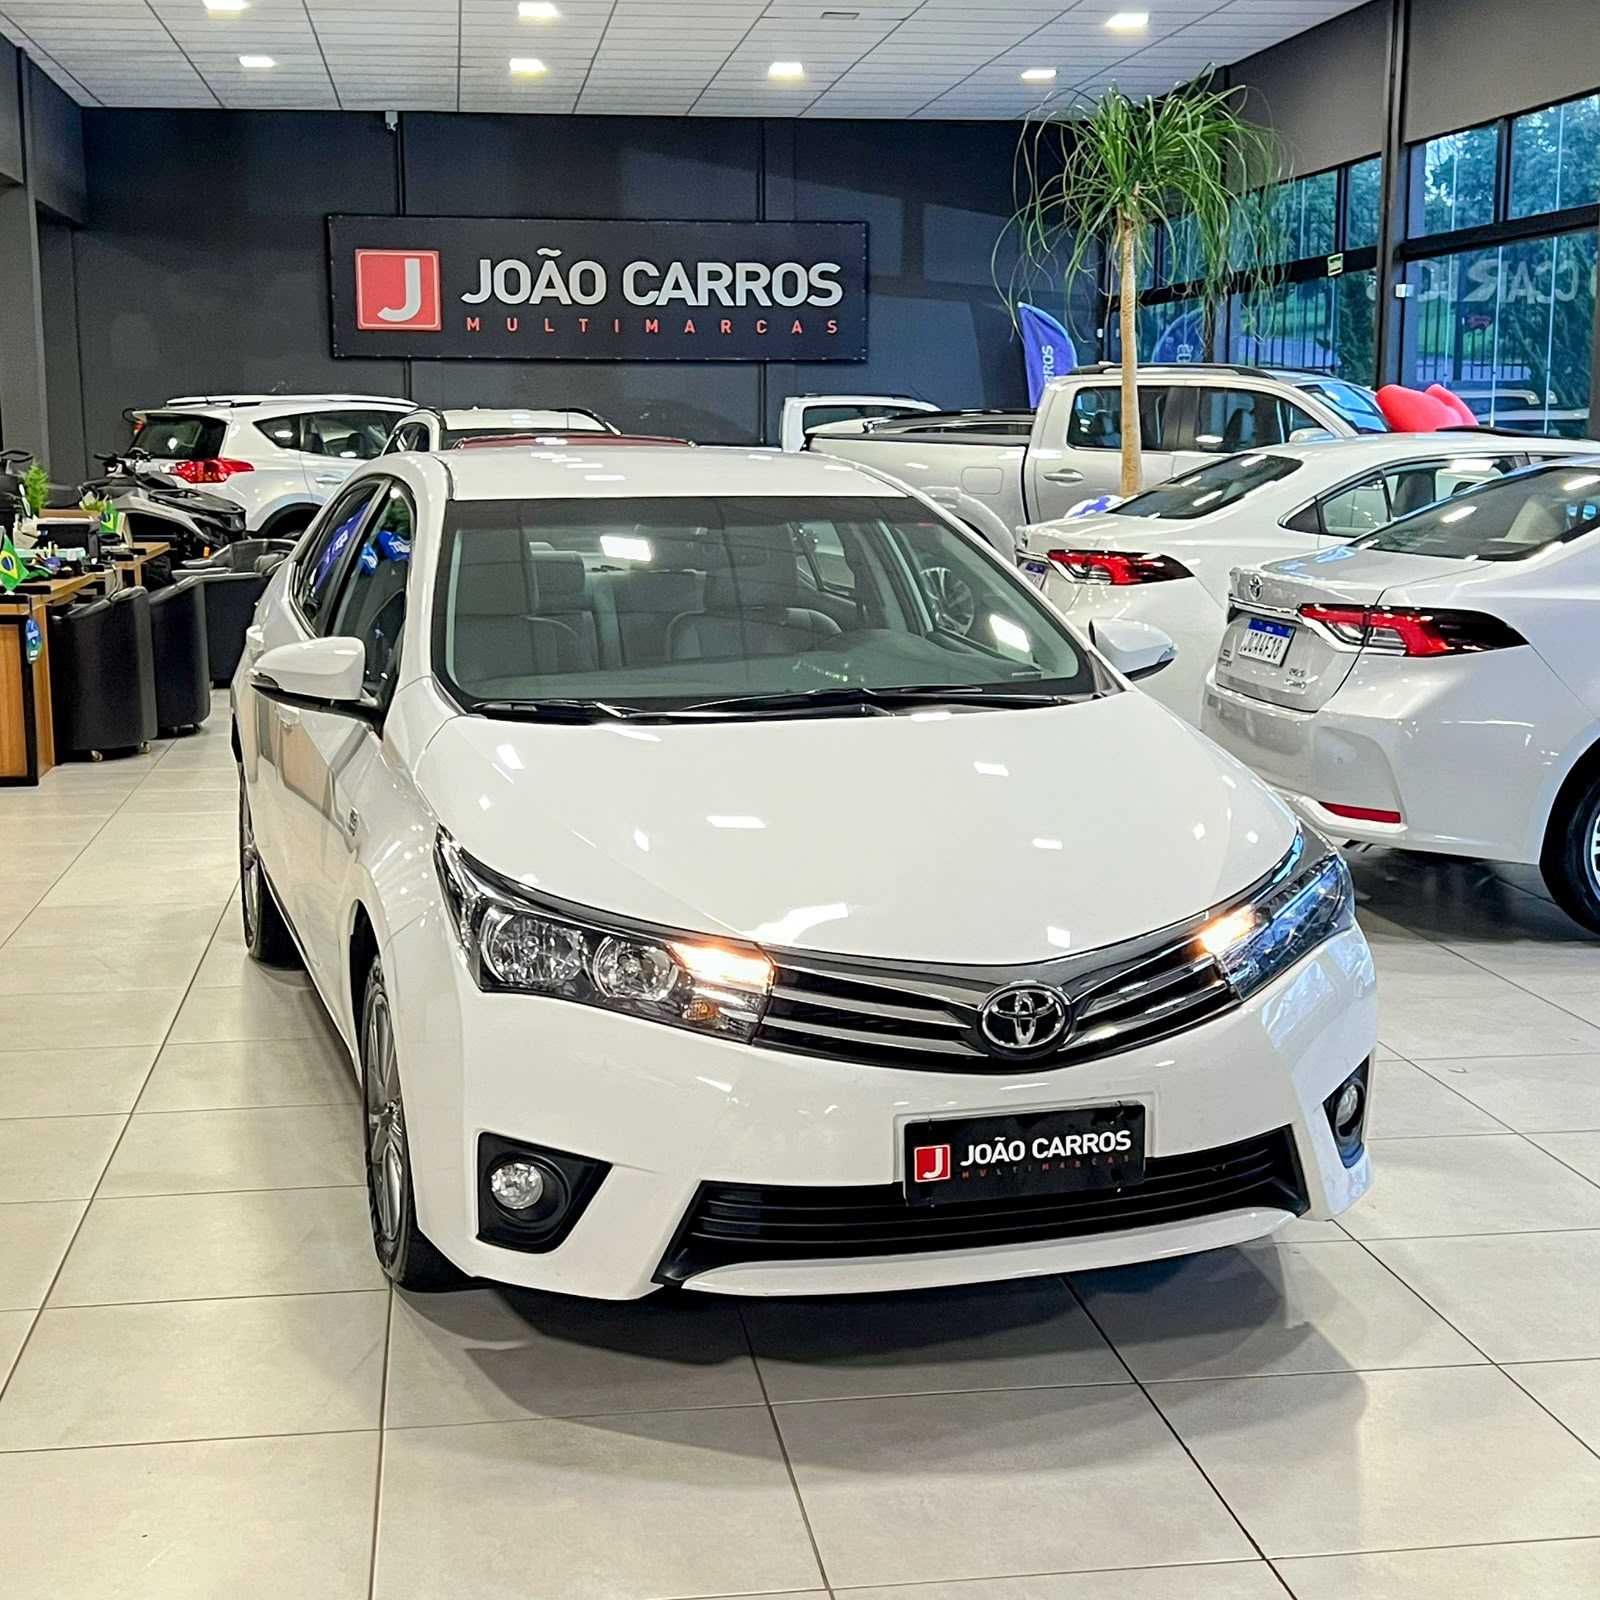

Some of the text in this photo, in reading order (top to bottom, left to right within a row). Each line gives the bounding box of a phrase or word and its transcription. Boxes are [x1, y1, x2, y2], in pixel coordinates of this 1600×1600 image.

[377, 257, 421, 322] J
[460, 247, 844, 308] JOÃO CARROS
[466, 317, 838, 335] MULTIMARCAS
[922, 1146, 944, 1179] J
[960, 1129, 1132, 1167] JOÃO CARROS
